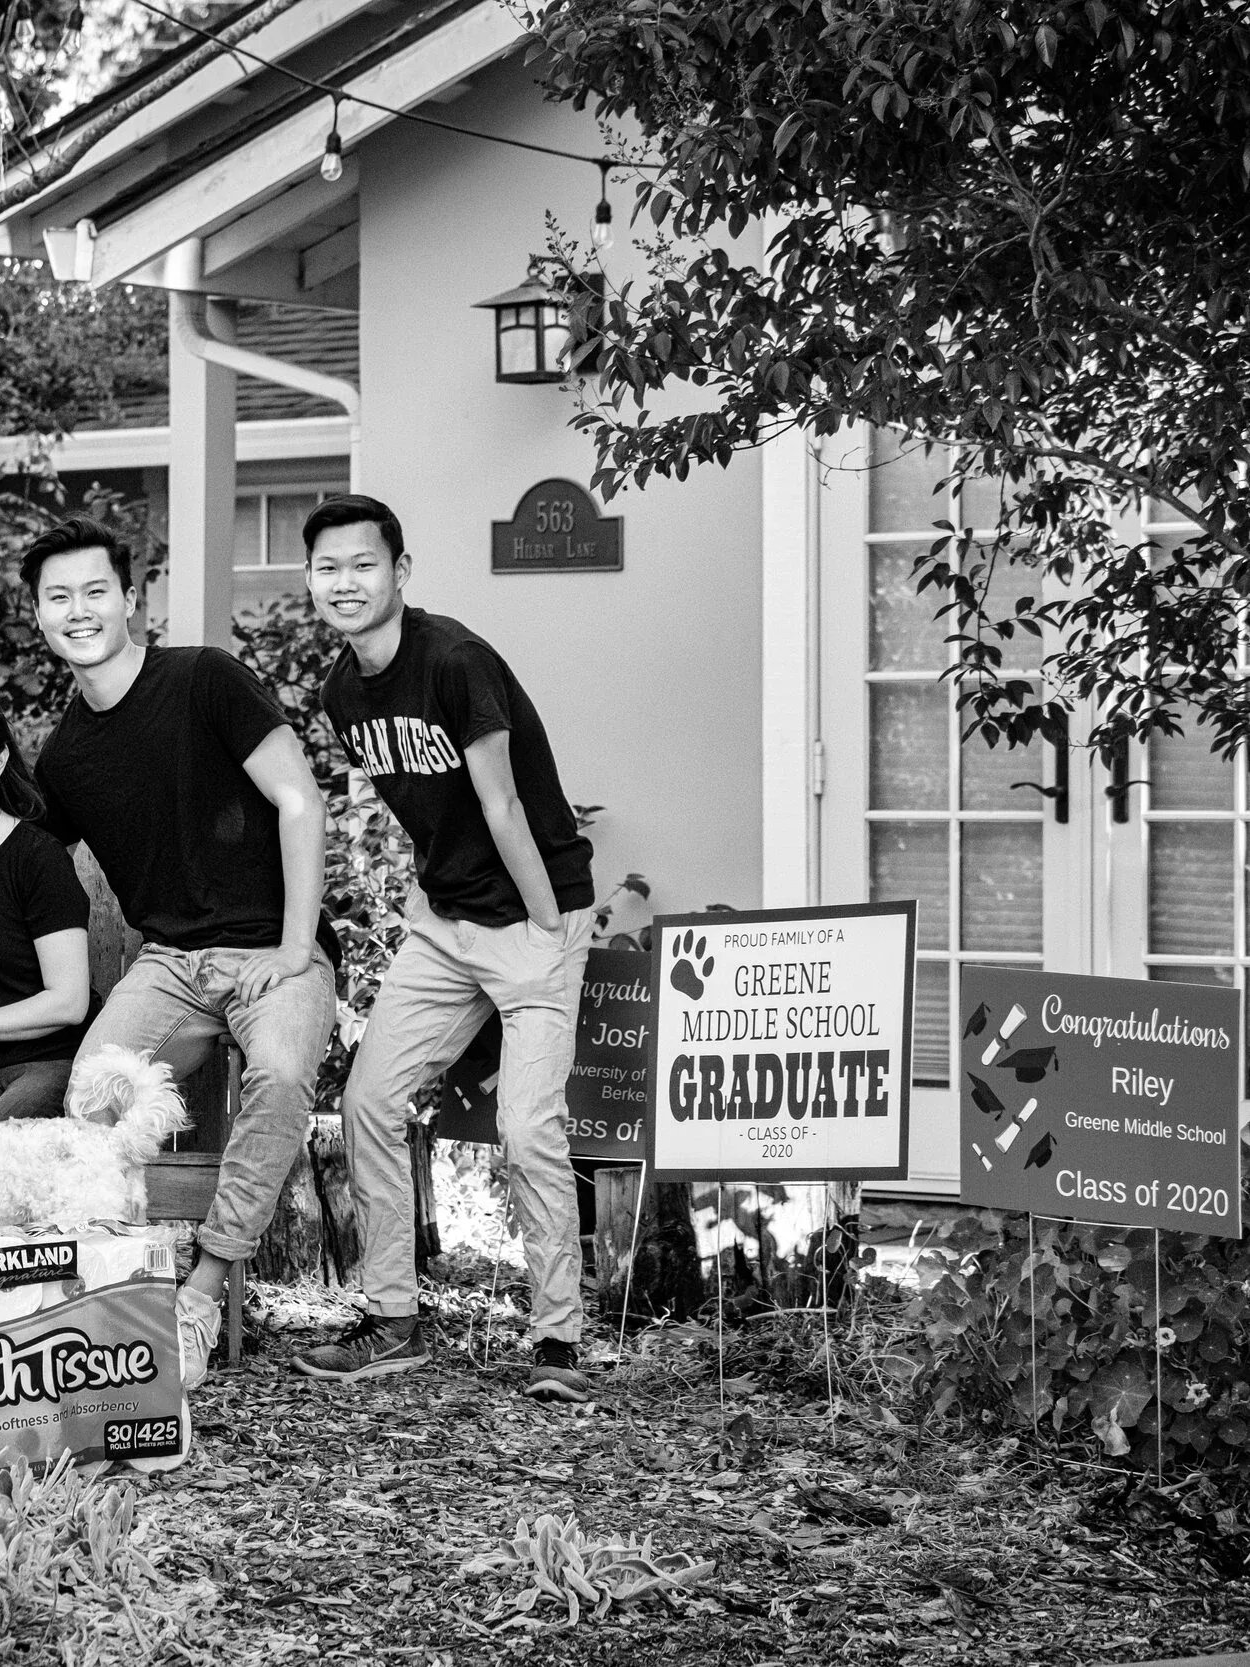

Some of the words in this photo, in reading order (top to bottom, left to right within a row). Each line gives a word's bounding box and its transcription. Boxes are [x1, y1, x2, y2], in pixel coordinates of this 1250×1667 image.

[536, 501, 574, 532] 563
[351, 718, 396, 777] SAN
[394, 716, 461, 775] DIEGO
[724, 933, 768, 948] PROUD
[771, 931, 815, 946] FAMILY
[817, 929, 833, 943] OF
[836, 929, 844, 942] A
[583, 978, 650, 1009] ngratu
[735, 961, 831, 996] GREENE
[682, 1007, 778, 1042] MIDDLE
[785, 1004, 880, 1039] SCHOOL
[1041, 994, 1230, 1050] Congratulations
[571, 1062, 628, 1083] niversity
[631, 1068, 647, 1082] of
[669, 1049, 890, 1122] GRADUATE
[1111, 1067, 1174, 1106] Riley
[564, 1117, 608, 1139] ass
[616, 1118, 643, 1142] of
[747, 1127, 787, 1141] CLASS
[790, 1126, 809, 1140] OF
[1065, 1111, 1119, 1132] Greene
[1124, 1118, 1172, 1139] Middle
[1177, 1124, 1226, 1145] School
[762, 1144, 793, 1158] 2020
[1056, 1169, 1126, 1203] Class
[1135, 1180, 1159, 1207] of
[1167, 1183, 1229, 1216] 2020
[10, 1332, 154, 1399] Tissue
[70, 1401, 139, 1417] Absorbency
[107, 1425, 132, 1443] 30
[137, 1420, 178, 1442] 425
[110, 1442, 131, 1450] ROLLS
